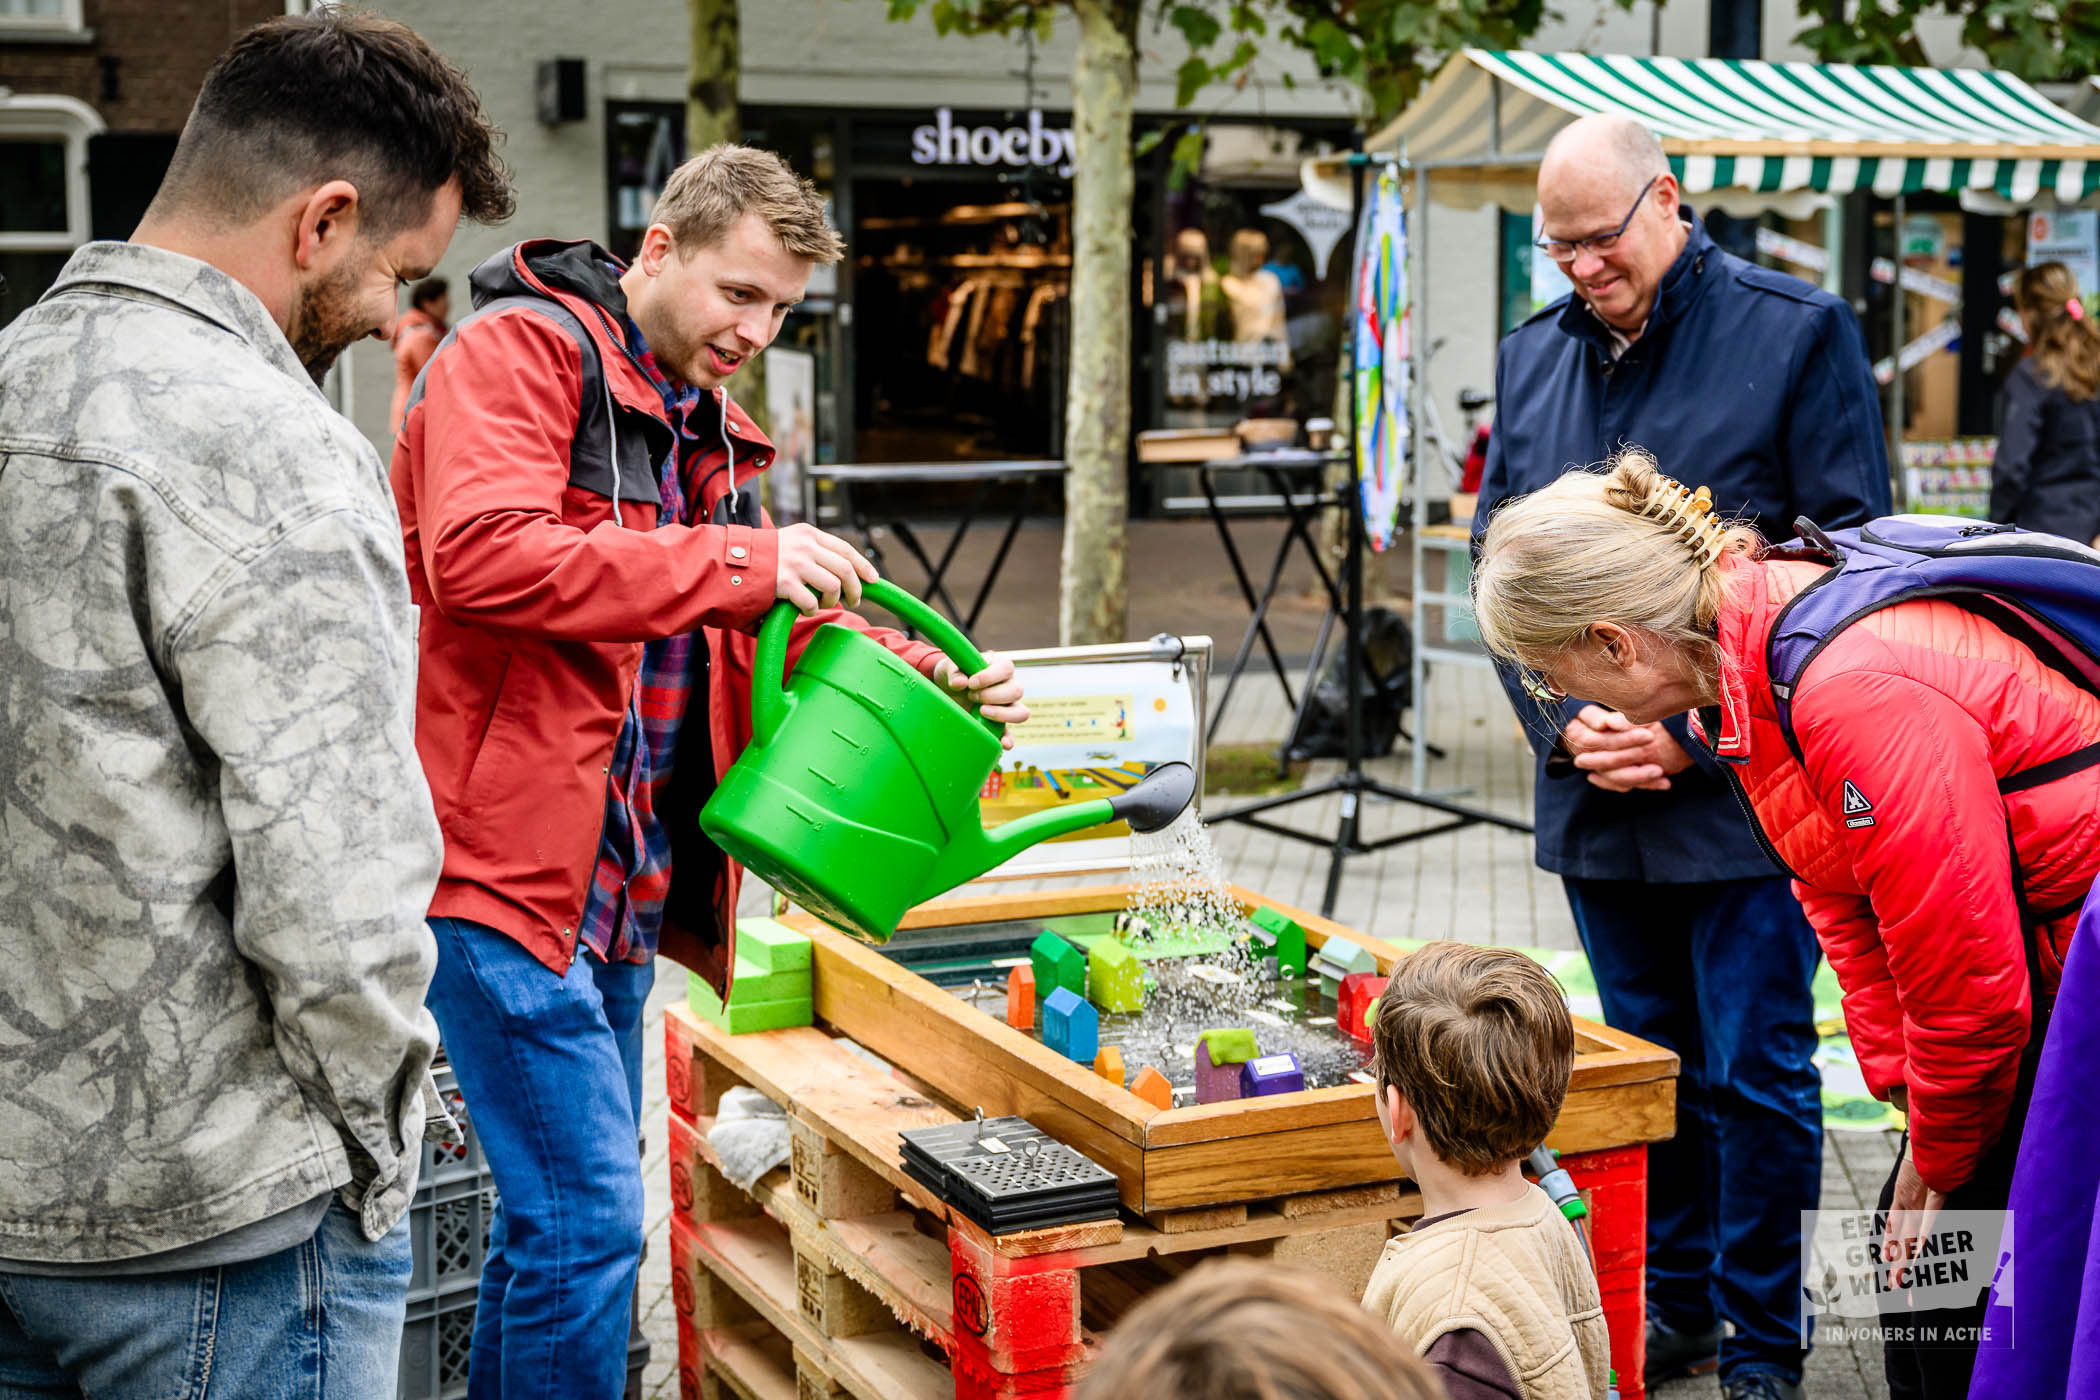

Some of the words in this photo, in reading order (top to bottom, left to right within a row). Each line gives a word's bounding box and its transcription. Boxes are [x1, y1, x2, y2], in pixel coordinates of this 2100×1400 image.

[912, 108, 1074, 179] shoeby
[1208, 366, 1281, 402] style
[959, 1281, 985, 1329] EPAL
